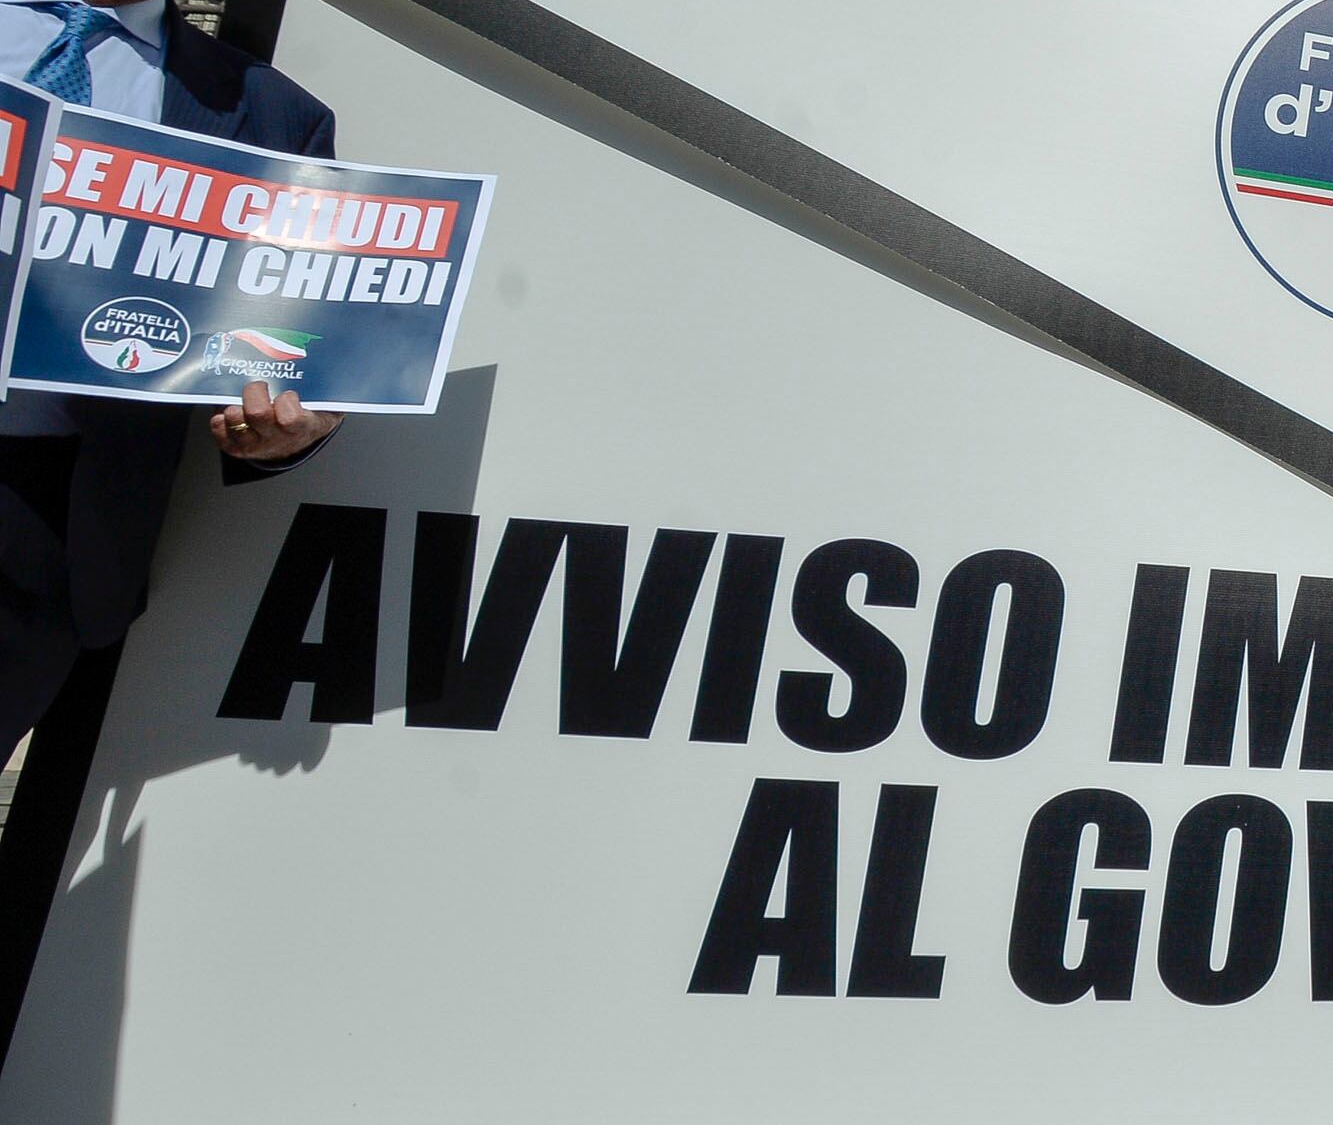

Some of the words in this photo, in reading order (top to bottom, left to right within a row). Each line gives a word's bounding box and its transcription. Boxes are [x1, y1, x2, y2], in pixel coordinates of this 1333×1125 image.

[118, 159, 213, 223] MI
[221, 184, 445, 251] CHIUDI
[32, 206, 128, 270] ON
[133, 226, 228, 289] MI
[237, 246, 452, 306] CHIEDI
[94, 320, 181, 344] d'ITALIA
[106, 308, 180, 329] FRATELLI
[221, 358, 296, 371] GIOVENTÙ
[229, 368, 304, 380] NAZIONALE
[215, 502, 1066, 761] AVVISO
[686, 776, 946, 1000] AL
